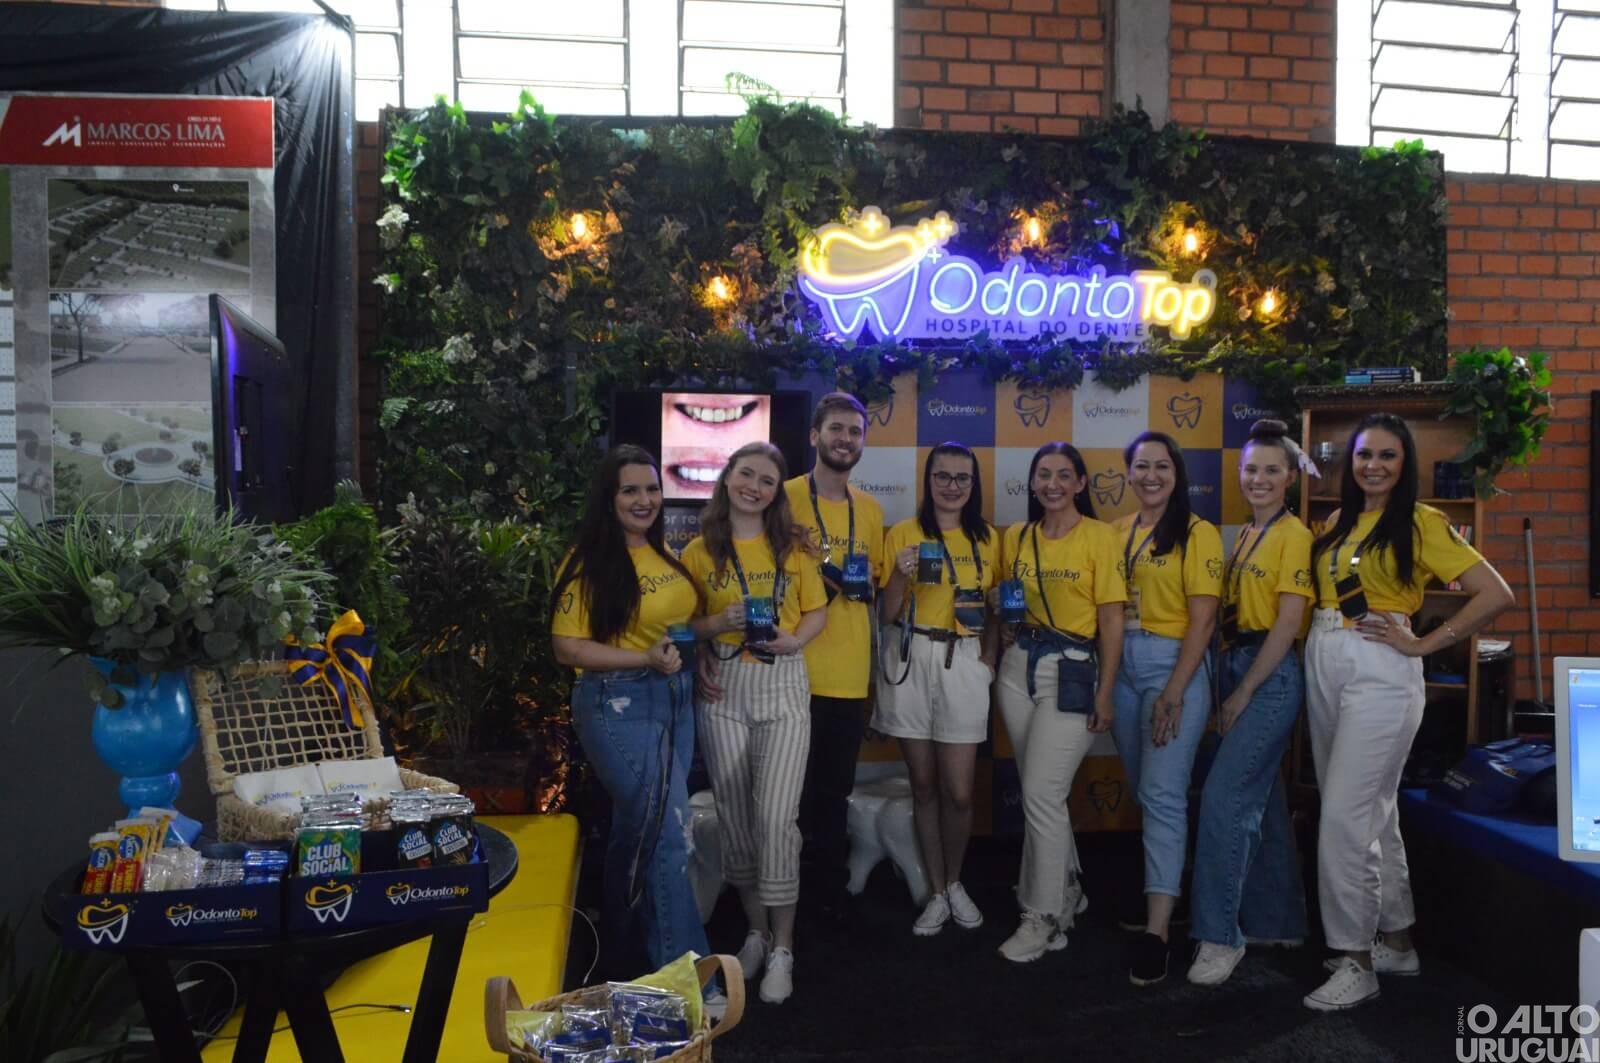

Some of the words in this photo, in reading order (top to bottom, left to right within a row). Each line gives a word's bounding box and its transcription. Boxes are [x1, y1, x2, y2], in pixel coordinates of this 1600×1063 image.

[87, 123, 172, 141] MARCOS
[176, 123, 225, 142] LIMA
[930, 262, 1212, 334] OdontoTop
[926, 318, 1028, 336] HOSPITAL
[1039, 322, 1068, 336] DO
[1079, 322, 1144, 337] DENTE
[403, 830, 423, 842] CLUB
[307, 843, 343, 862] CLUB
[410, 884, 470, 900] OdontoTop
[192, 906, 258, 921] OdontoTop
